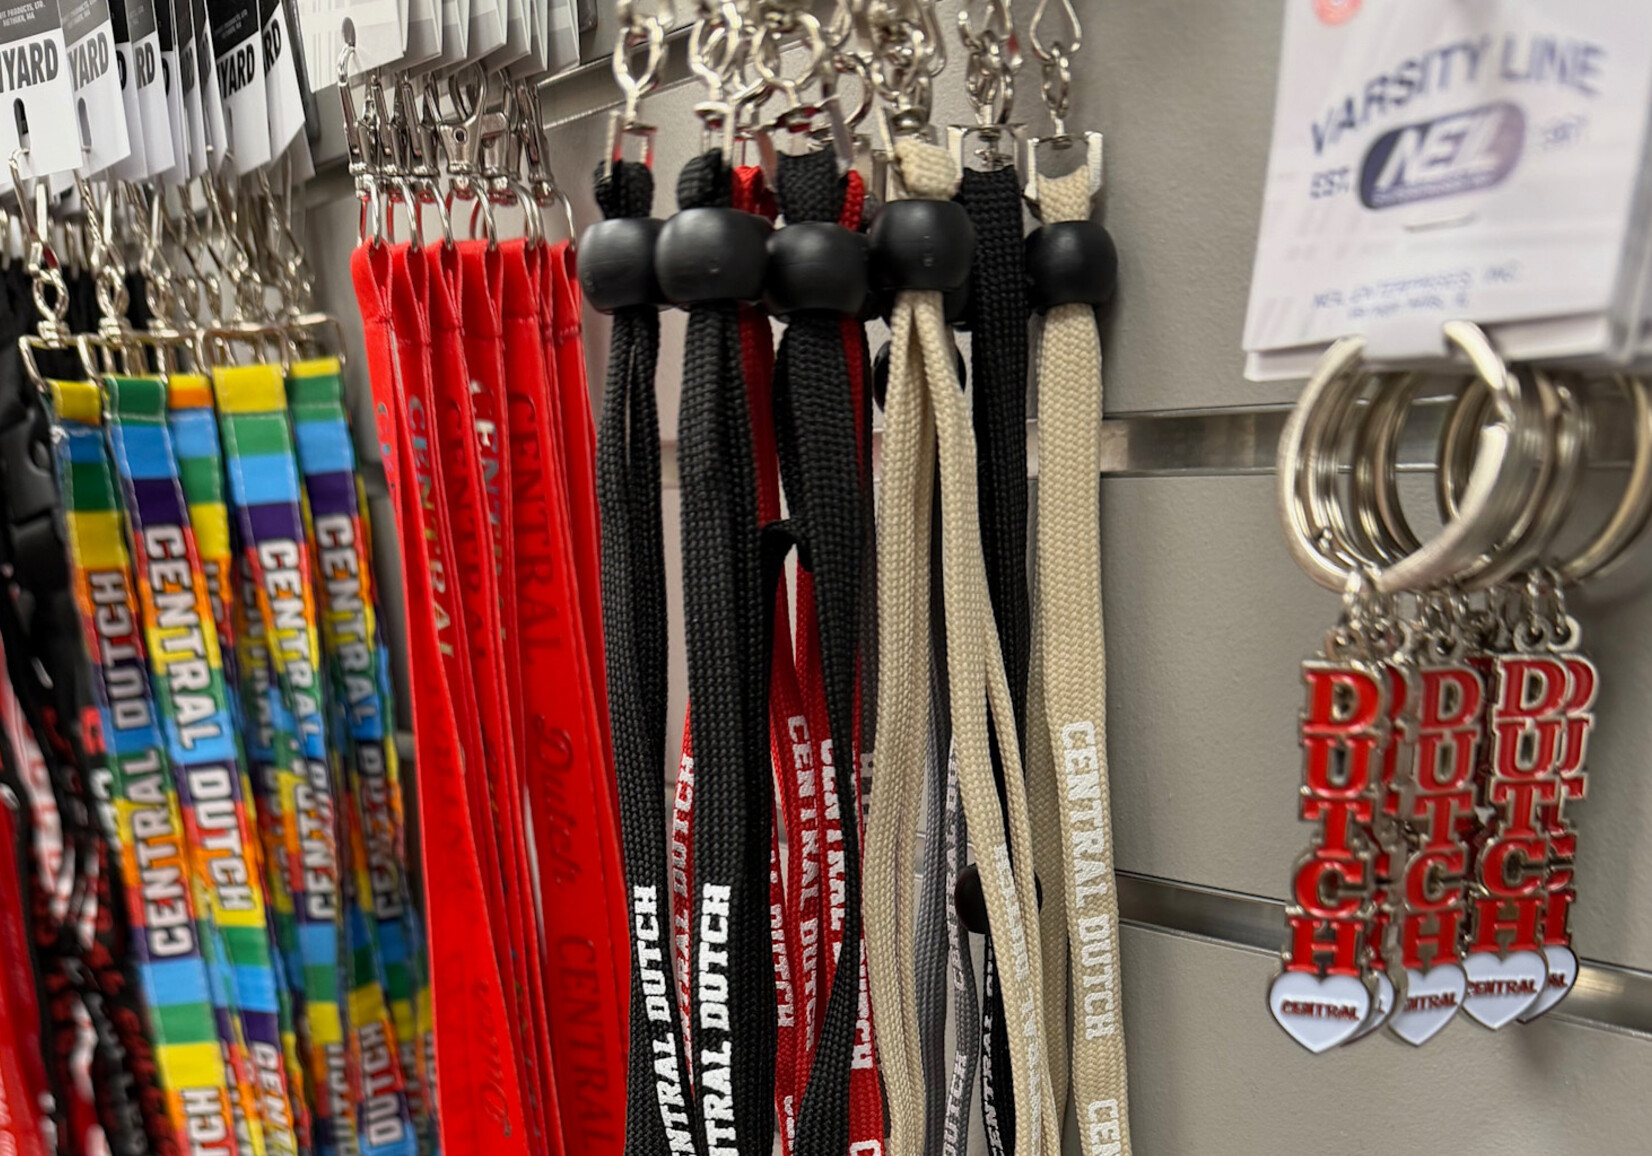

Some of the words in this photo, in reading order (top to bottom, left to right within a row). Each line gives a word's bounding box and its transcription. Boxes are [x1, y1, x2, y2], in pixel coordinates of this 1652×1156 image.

[0, 37, 59, 93] YARD
[1311, 35, 1493, 156] VARSITY
[1502, 35, 1607, 99] LINE
[88, 571, 151, 731] DUTCH
[145, 523, 209, 750] CENTRAL
[188, 765, 253, 911] DUTCH
[257, 539, 320, 742] CENTRAL
[316, 514, 377, 727] CENTRAL
[125, 748, 194, 957] CENTRAL
[788, 715, 821, 912] CENTRAL
[1061, 720, 1109, 911] CENTRAL
[1287, 668, 1381, 974] DUTCH
[1402, 668, 1482, 968] DUTCH
[1470, 656, 1570, 954] DUTCH
[557, 934, 615, 1151] CENTRAL
[634, 885, 673, 1025] DUTCH
[698, 883, 732, 1032] DUTCH
[1079, 914, 1117, 1041] DUTCH
[1280, 999, 1361, 1021] CENTRAL
[359, 1021, 404, 1147] DUTCH
